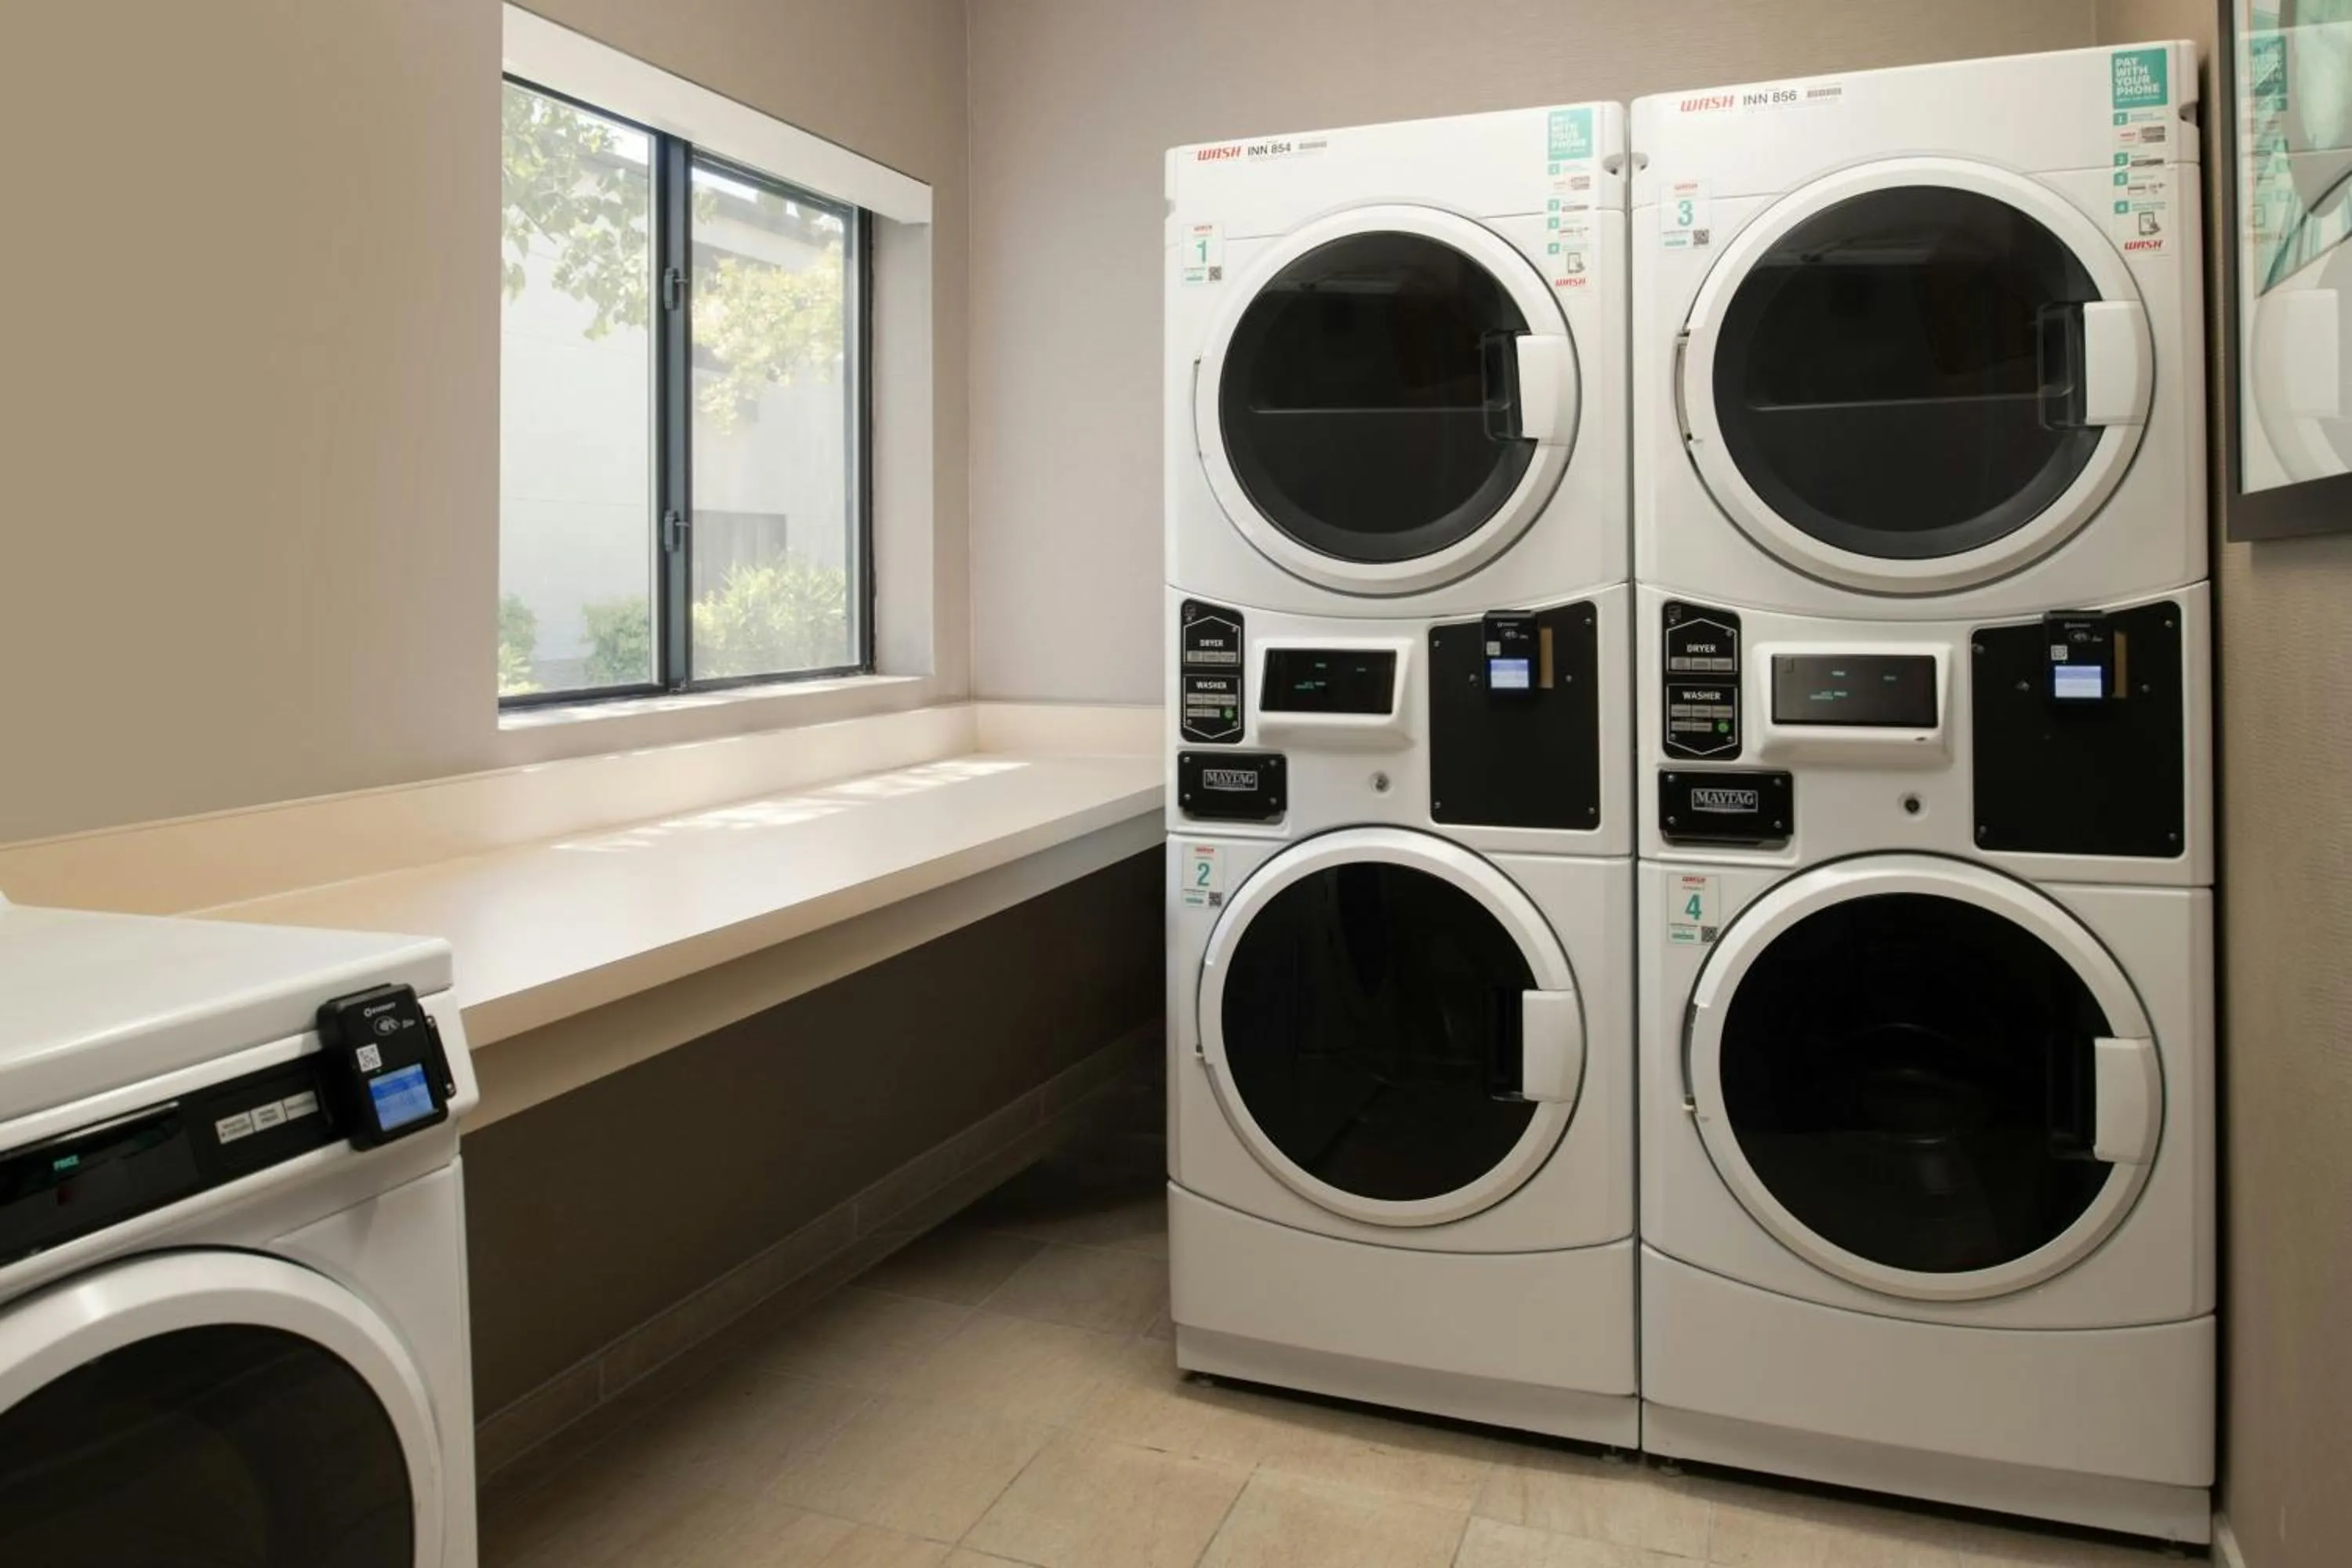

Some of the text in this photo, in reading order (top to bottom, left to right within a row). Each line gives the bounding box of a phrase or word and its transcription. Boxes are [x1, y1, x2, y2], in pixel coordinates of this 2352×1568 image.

[2116, 57, 2139, 69] PAY
[2116, 64, 2148, 77] WITH
[2115, 74, 2151, 86] YOUR
[2116, 82, 2161, 96] PHONE
[1680, 90, 1797, 112] WASH INN 856
[1197, 143, 1291, 161] WASH INN 854
[1678, 200, 1693, 227] 3
[1196, 240, 1207, 263] 1
[2124, 240, 2164, 251] WASH
[1686, 644, 1716, 653] DRYER
[1196, 681, 1227, 690] WASHER
[1682, 691, 1721, 700] WASHER
[1207, 771, 1254, 784] MAYTAG
[1695, 790, 1754, 804] MAYTAG
[1197, 862, 1210, 887] 2
[1684, 894, 1702, 920] 4
